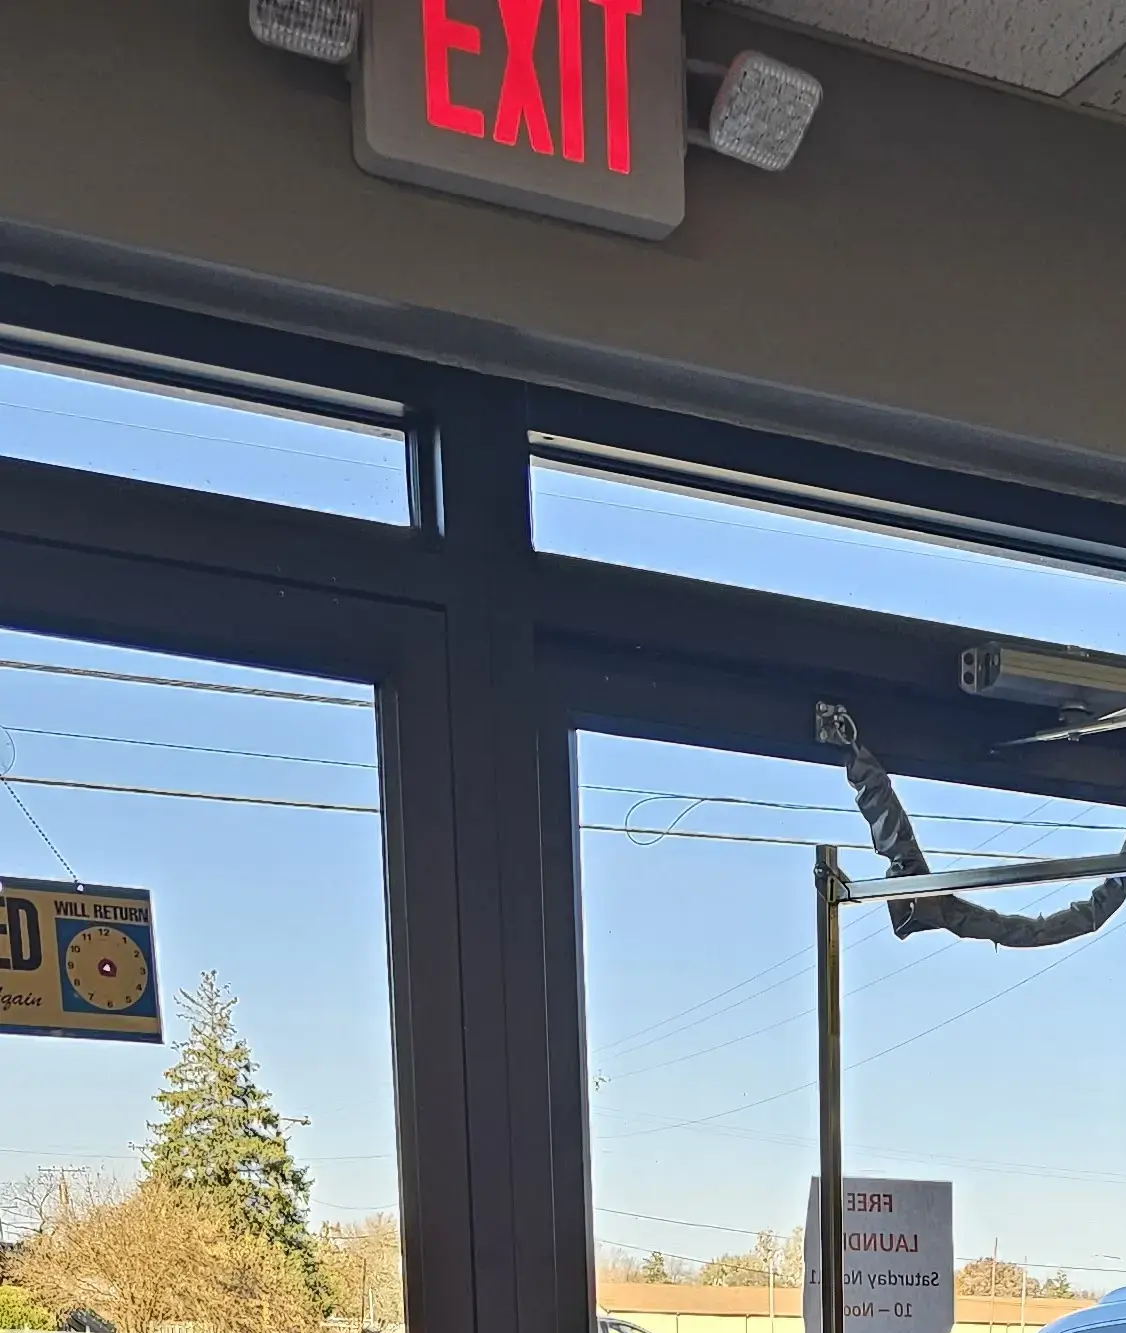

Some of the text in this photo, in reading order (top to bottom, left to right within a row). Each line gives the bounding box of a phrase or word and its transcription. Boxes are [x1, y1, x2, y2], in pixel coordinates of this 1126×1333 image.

[423, 0, 643, 175] EXIT
[54, 900, 149, 923] WILL RETURN
[98, 928, 110, 937] 12
[82, 933, 92, 941] 11
[70, 945, 80, 953] 10
[133, 950, 140, 958] 2
[140, 967, 146, 975] 3
[74, 979, 80, 987] 8
[0, 986, 42, 1011] gain
